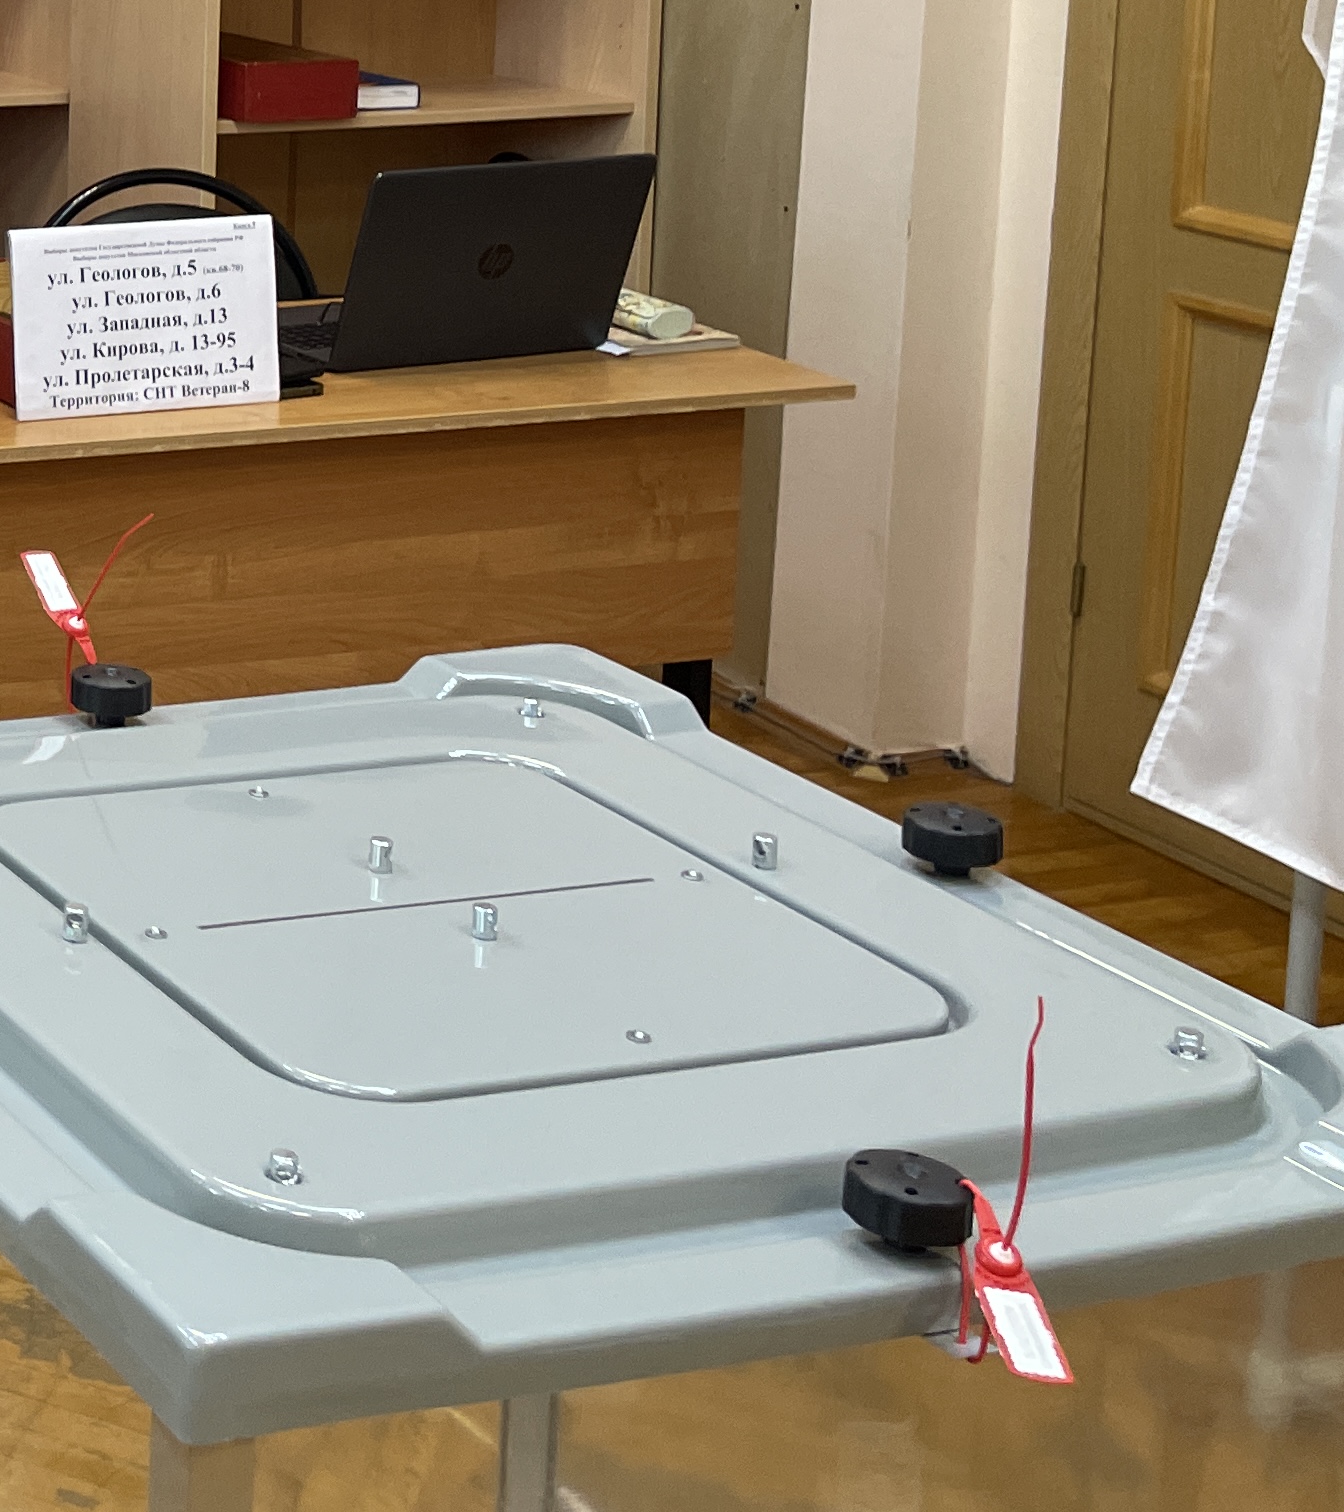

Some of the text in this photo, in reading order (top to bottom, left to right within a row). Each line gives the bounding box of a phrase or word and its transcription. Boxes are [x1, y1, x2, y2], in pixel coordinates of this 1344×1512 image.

[47, 271, 74, 290] ул.
[79, 265, 167, 284] Геологов,
[171, 259, 197, 277] д.5
[72, 283, 222, 314] ул. Геологов, д.6
[66, 307, 229, 339] ул. Западная, д.13
[60, 332, 237, 366] ул. Кирова, д. 13-95
[43, 355, 255, 393] ул. Пролетарская, д.3-4
[49, 390, 140, 411] Территория:
[143, 385, 179, 402] СНТ
